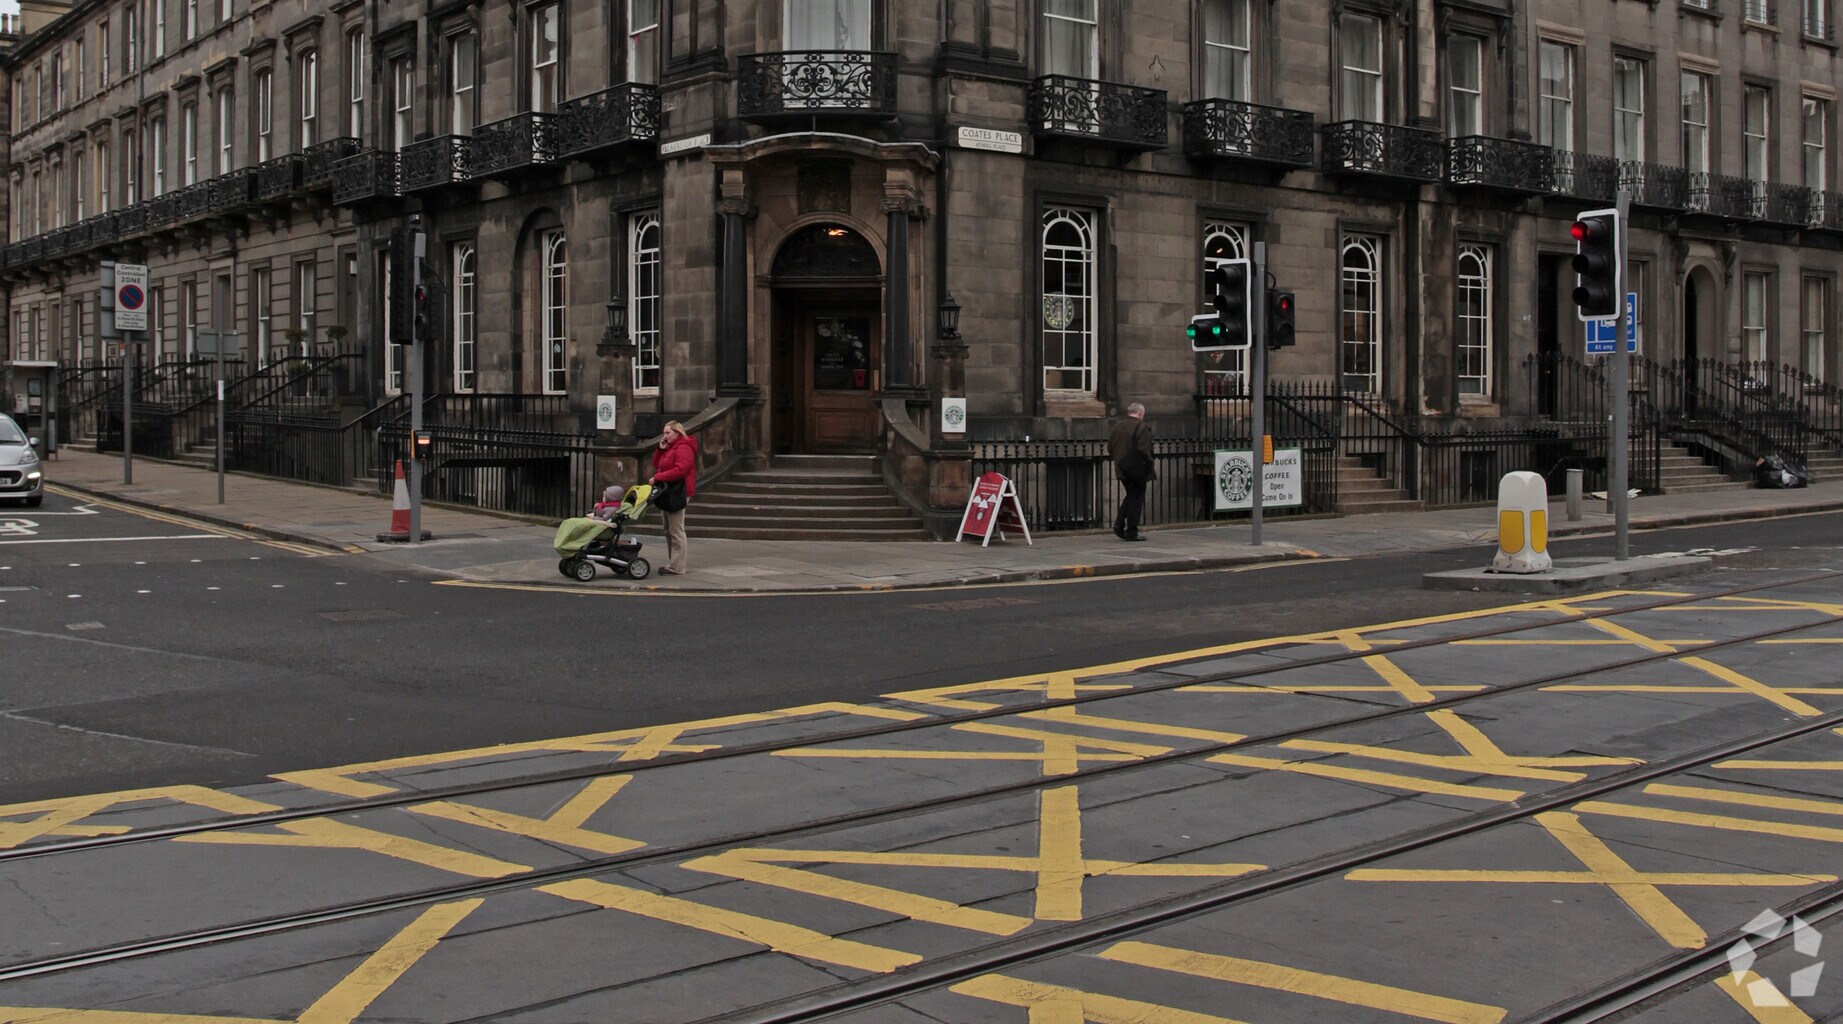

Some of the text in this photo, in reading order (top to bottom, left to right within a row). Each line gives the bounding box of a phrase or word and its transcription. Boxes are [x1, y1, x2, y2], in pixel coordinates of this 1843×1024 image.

[962, 128, 1018, 143] COATES PLACE
[1220, 458, 1252, 479] STARBUCKS
[1264, 472, 1290, 480] COFFEE
[1269, 482, 1285, 491] Open
[1223, 489, 1249, 502] COFFEE
[1261, 493, 1278, 502] Come
[1278, 493, 1287, 501] On
